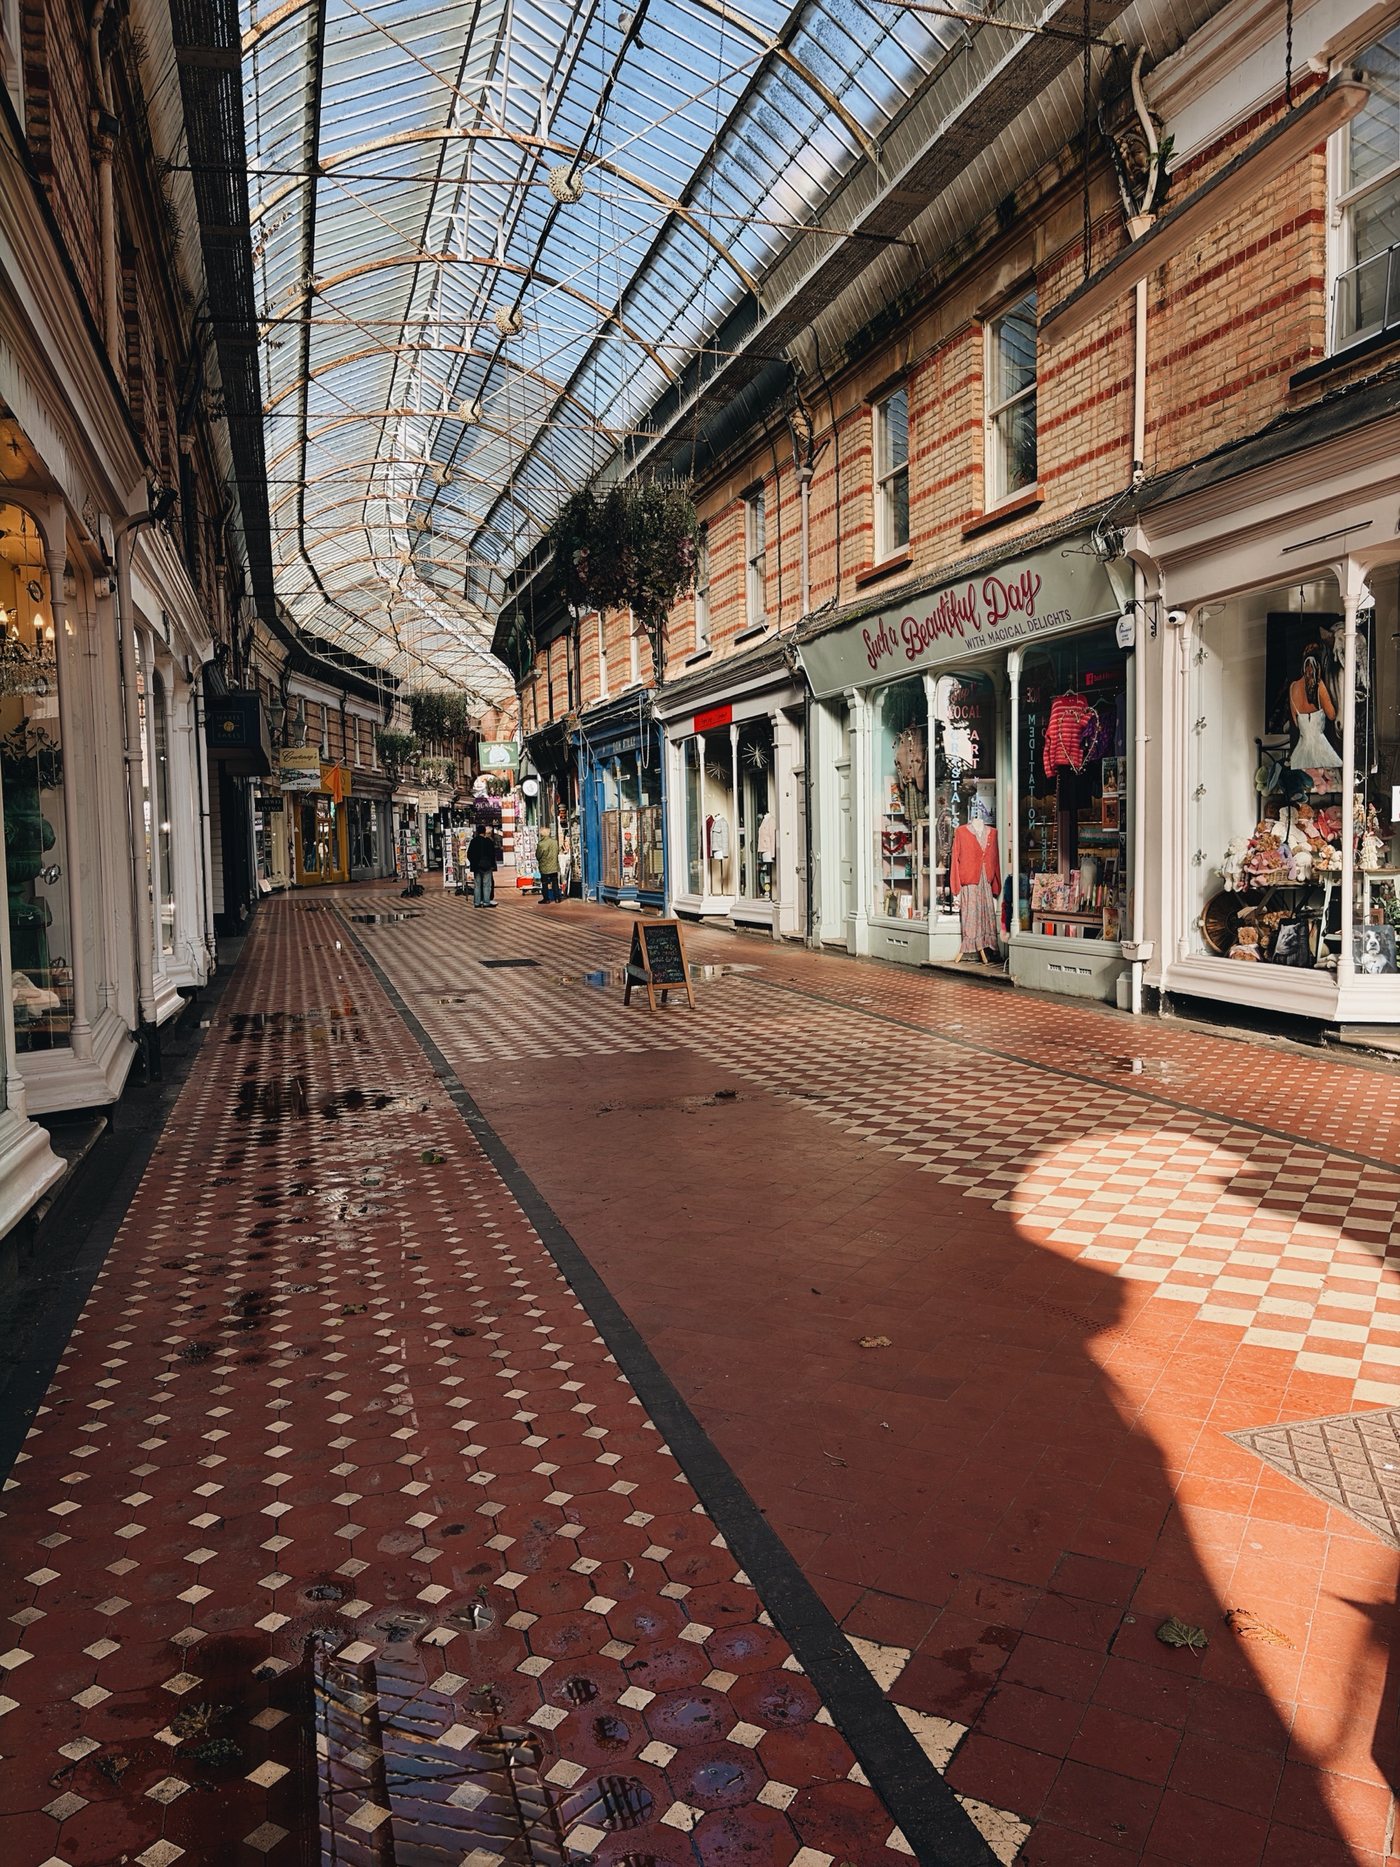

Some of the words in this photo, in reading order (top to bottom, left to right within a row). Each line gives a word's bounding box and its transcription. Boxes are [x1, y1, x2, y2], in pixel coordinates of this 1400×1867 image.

[862, 616, 892, 670] Such
[888, 625, 899, 649] a
[900, 583, 982, 662] Beautiful
[982, 569, 1042, 627] Day
[964, 635, 987, 651] WITH
[988, 623, 1027, 645] MAGICAL
[1027, 608, 1073, 633] DELIGHTS
[947, 705, 982, 720] LOCAL
[970, 729, 980, 770] ART
